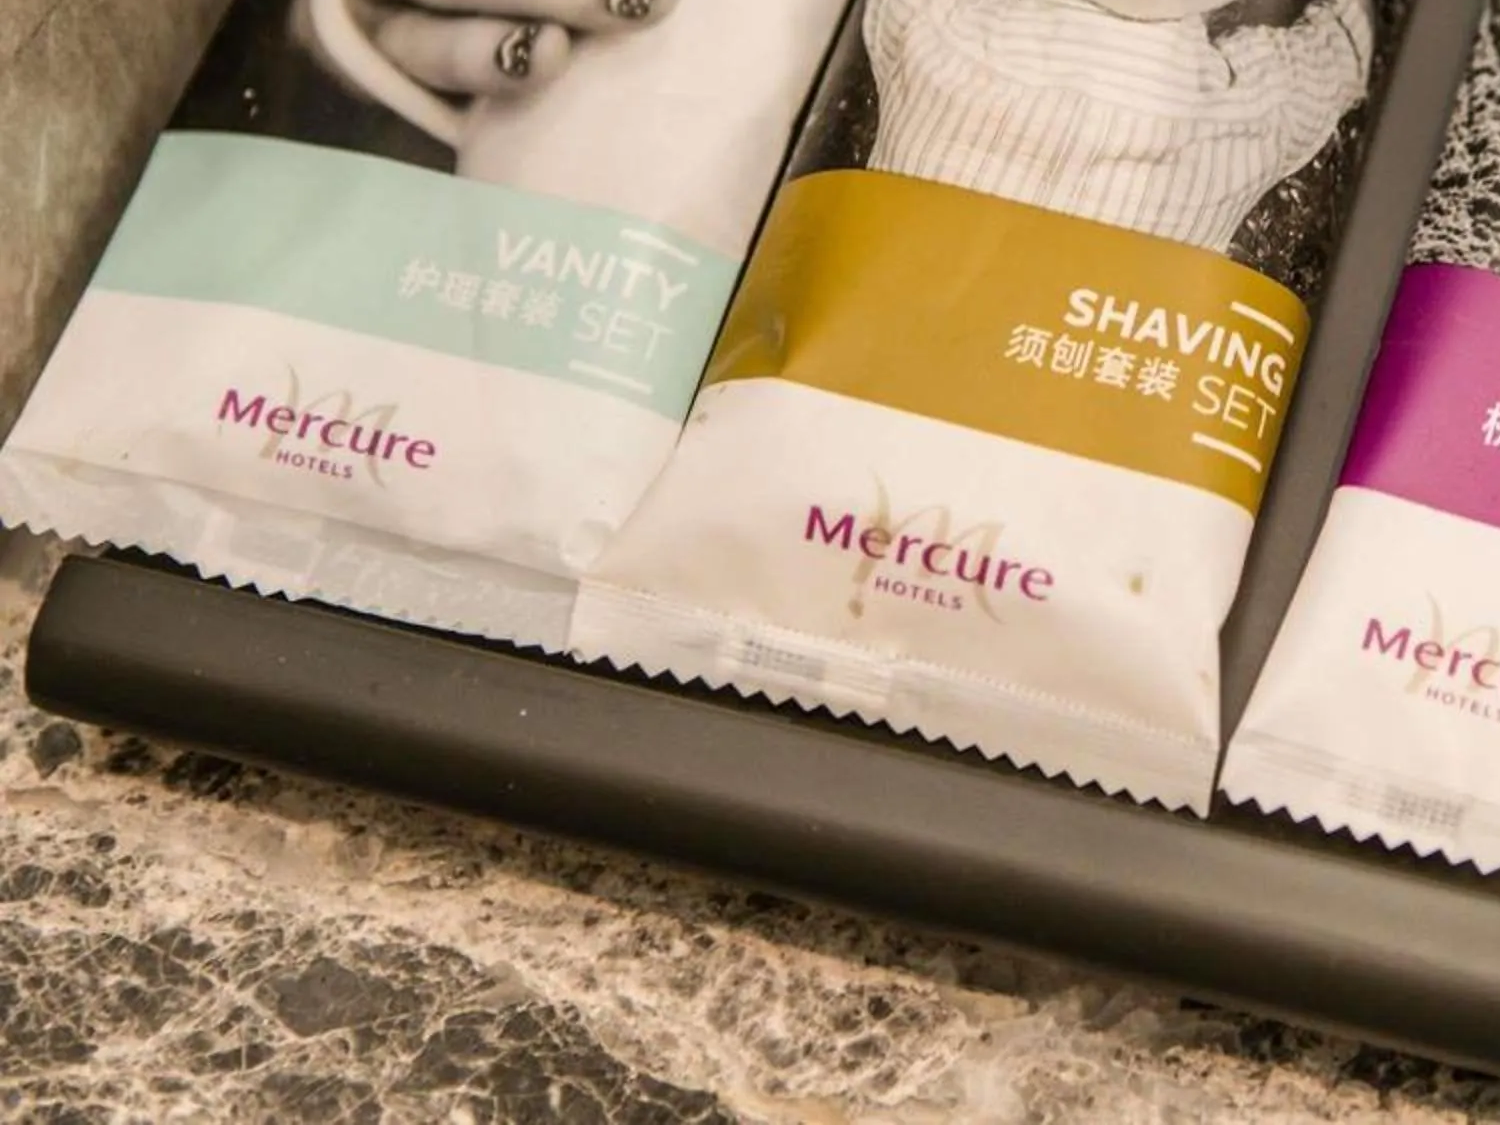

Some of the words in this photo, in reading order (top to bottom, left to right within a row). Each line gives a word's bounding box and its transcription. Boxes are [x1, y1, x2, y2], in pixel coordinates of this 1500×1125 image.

[397, 256, 564, 329] 护理套装
[573, 301, 676, 360] SET
[496, 228, 688, 312] VANITY
[1003, 322, 1181, 402] 须刨套装
[1191, 373, 1277, 441] SET
[1064, 287, 1288, 396] SHAVING
[216, 388, 437, 471] Mercure
[275, 448, 354, 480] HOTELS
[803, 505, 1056, 602] Mercure
[874, 575, 965, 611] HOTELS
